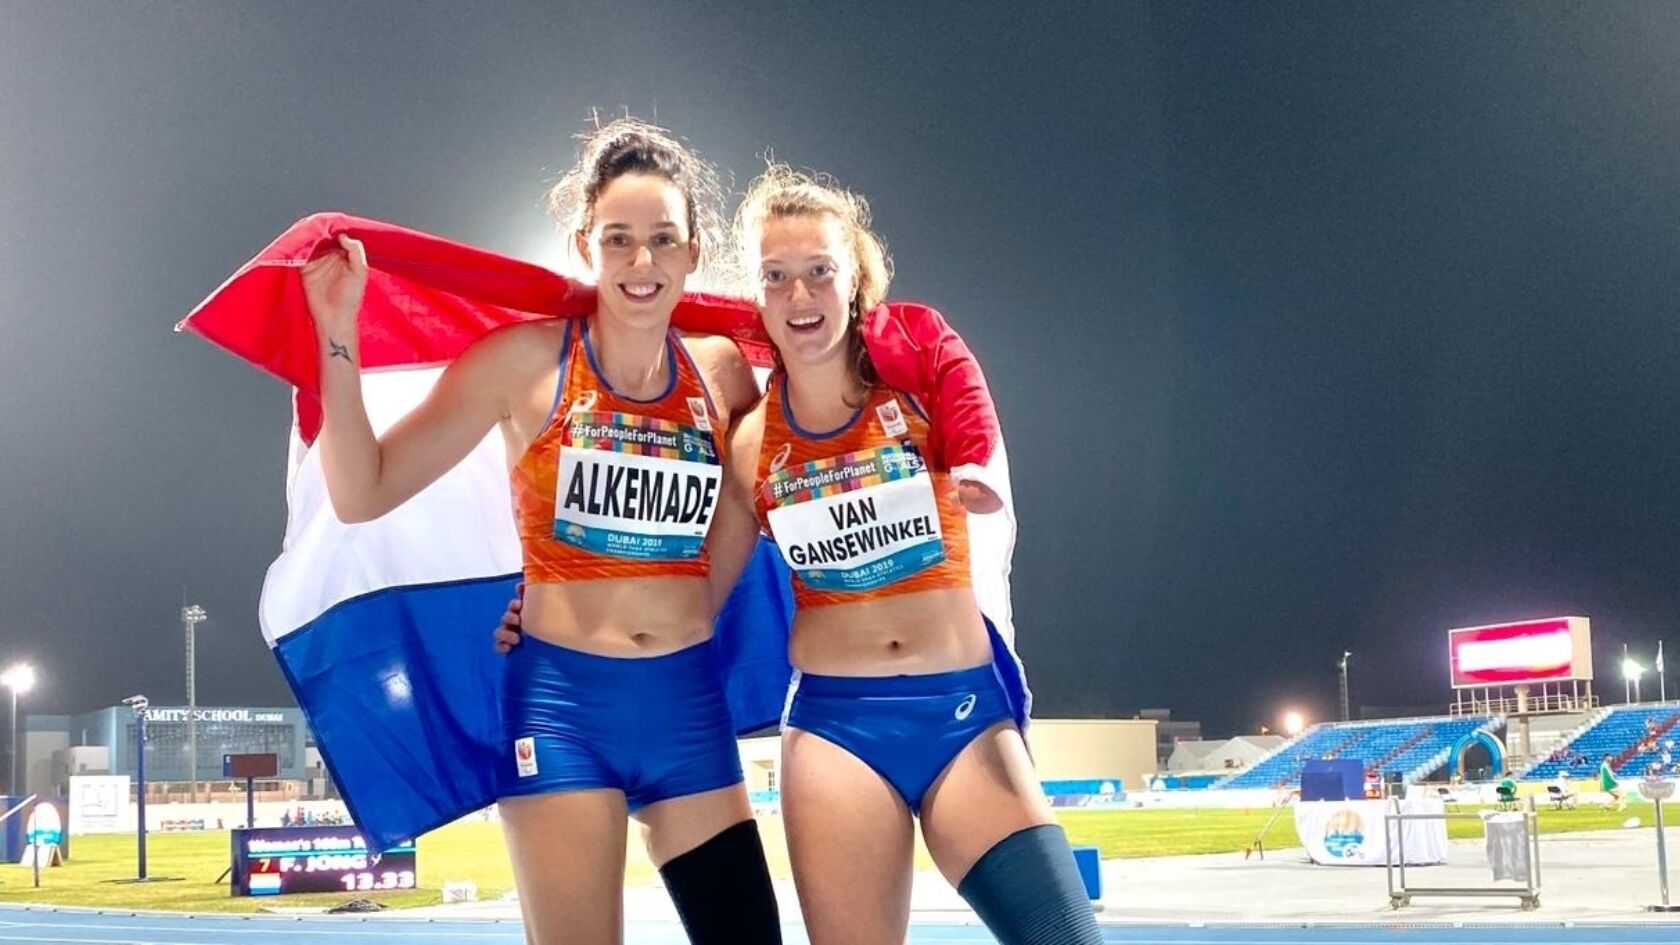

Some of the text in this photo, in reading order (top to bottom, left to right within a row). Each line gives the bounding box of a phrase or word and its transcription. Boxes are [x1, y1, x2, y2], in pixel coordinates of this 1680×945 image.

[572, 422, 677, 447] #ForPeopleForPlanet
[773, 462, 877, 498] #ForPeopleForPlanet
[564, 461, 717, 525] ALKEMADE
[829, 497, 878, 530] VAN
[607, 533, 640, 545] DUBAI
[789, 516, 936, 565] GANSEWINKEL
[841, 567, 870, 579] DUBAI
[872, 559, 894, 573] 2019
[143, 709, 190, 721] AMITY
[193, 708, 252, 722] SCHOOL
[259, 859, 271, 872] 7
[280, 855, 367, 872] F. JONG
[341, 871, 414, 890] 13.33
